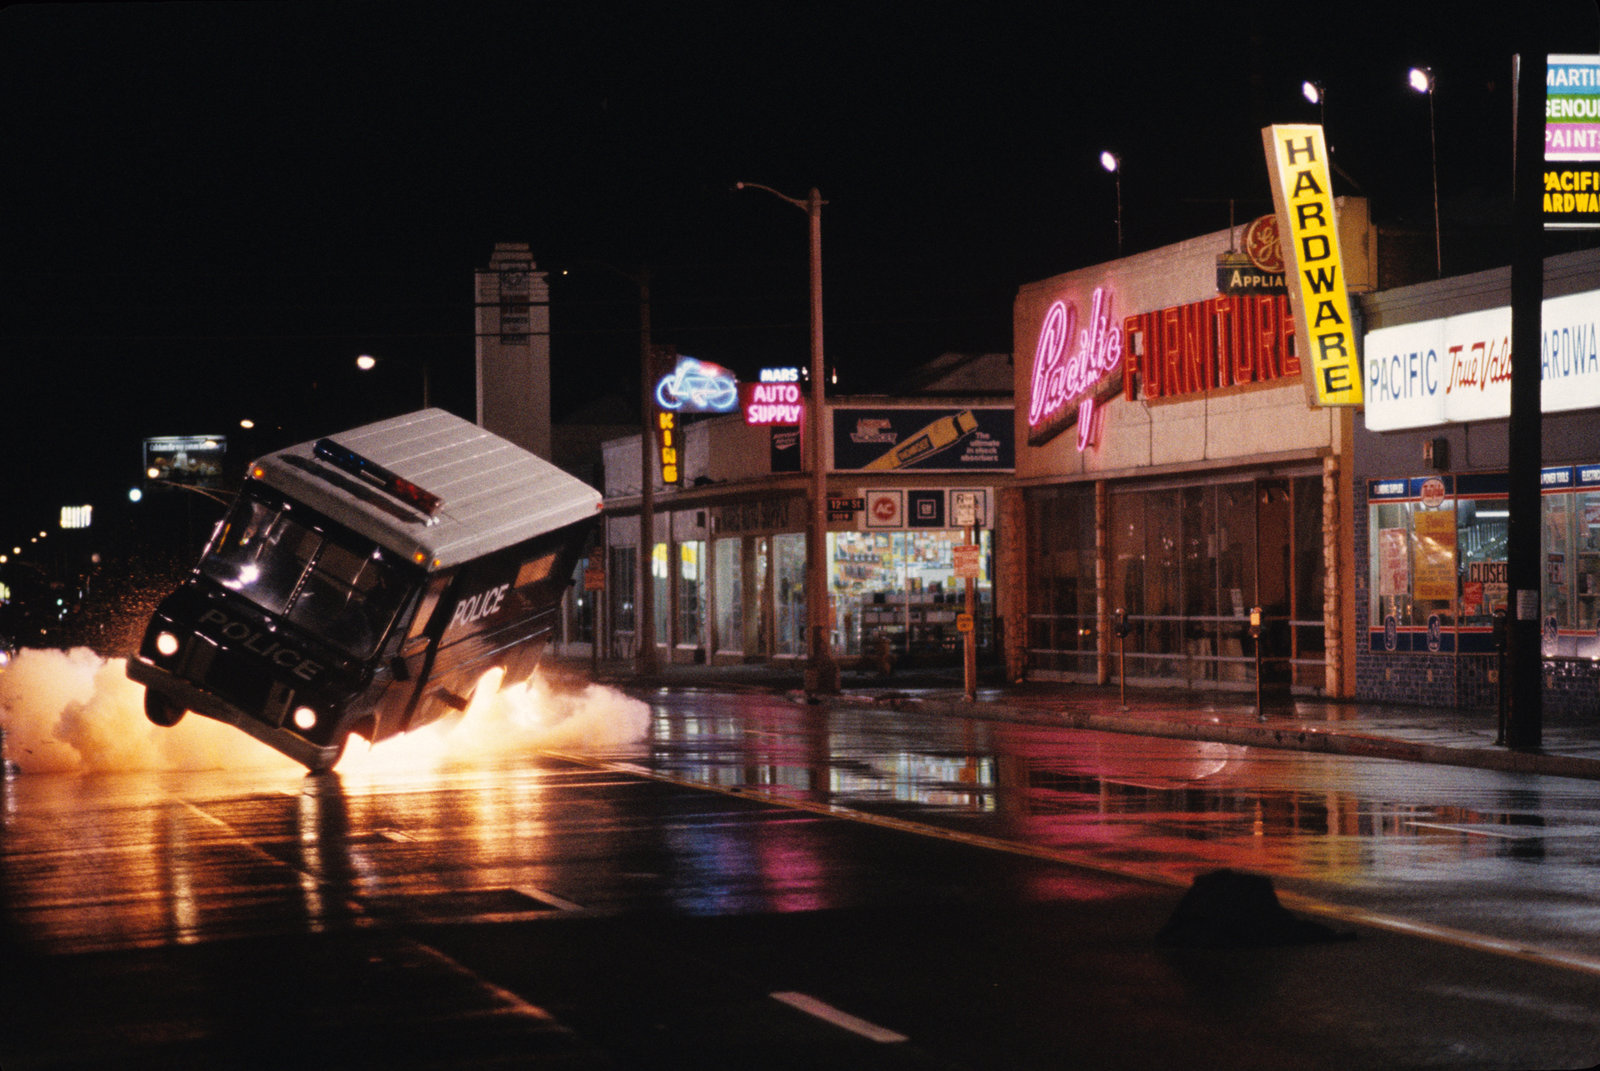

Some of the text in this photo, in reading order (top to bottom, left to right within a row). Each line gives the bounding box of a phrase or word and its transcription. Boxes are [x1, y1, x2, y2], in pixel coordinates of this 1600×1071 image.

[1546, 99, 1600, 117] ENOU
[1546, 130, 1600, 147] AINT
[1544, 171, 1600, 191] ACIFI
[1543, 193, 1600, 212] ARDWA
[1285, 135, 1353, 394] HARDWARE
[1230, 269, 1288, 287] APPLIA
[1123, 294, 1301, 401] FURNITURE
[1029, 287, 1121, 452] Pacific
[1369, 348, 1438, 403] PACIFIC
[1541, 322, 1599, 380] ARDWA
[760, 368, 799, 382] MARS
[753, 385, 799, 403] AUTO
[748, 404, 801, 423] SUPPLY
[660, 412, 677, 482] KING
[875, 503, 893, 514] AC
[450, 583, 510, 629] POLICE
[200, 607, 324, 680] POLICE
